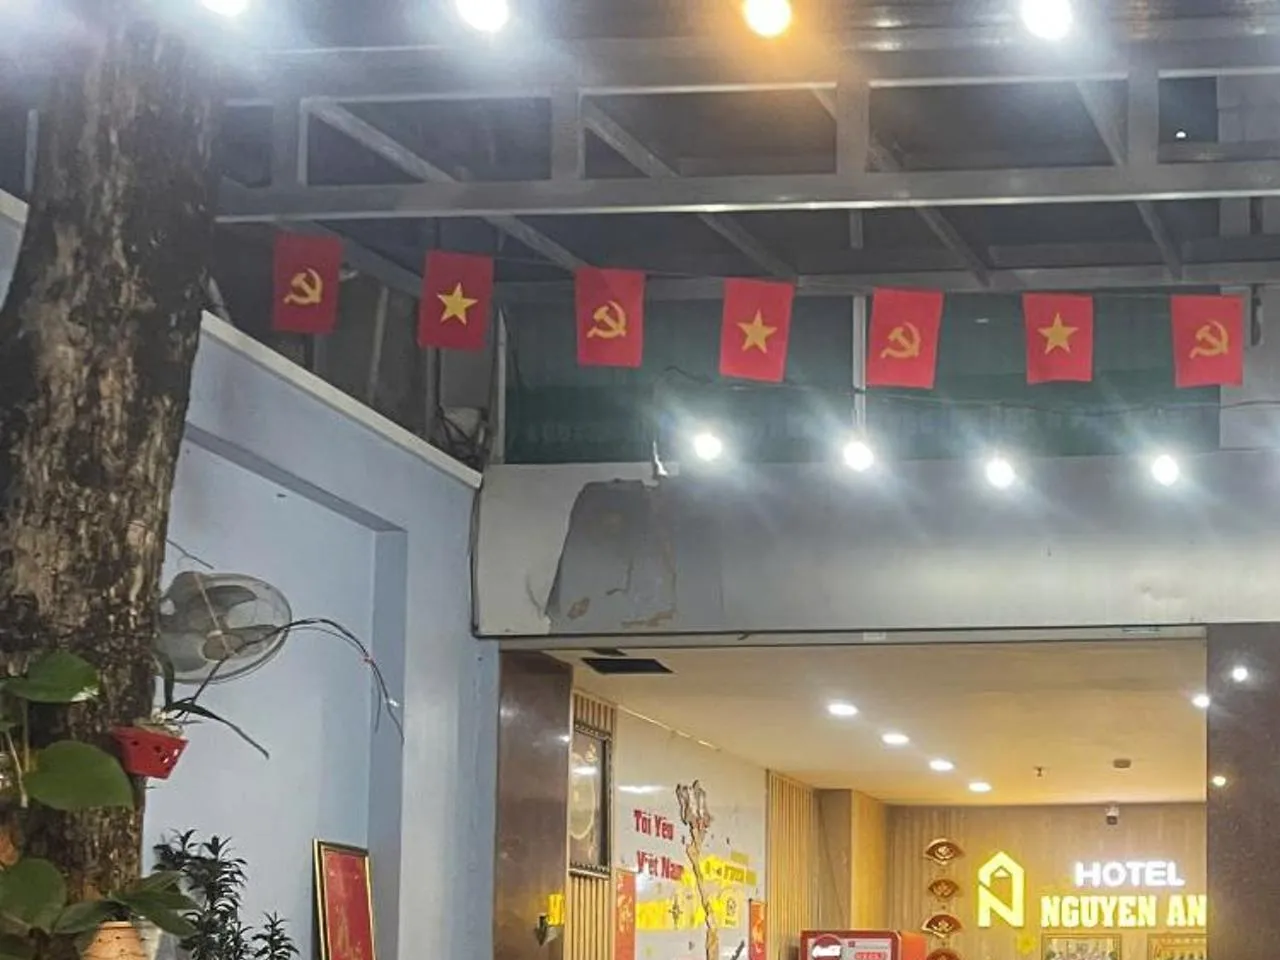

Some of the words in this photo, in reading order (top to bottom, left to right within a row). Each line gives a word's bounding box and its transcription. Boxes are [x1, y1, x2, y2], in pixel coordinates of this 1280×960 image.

[654, 814, 675, 840] Yêu
[1074, 861, 1186, 888] HOTEL
[1040, 894, 1158, 928] NGUYEN
